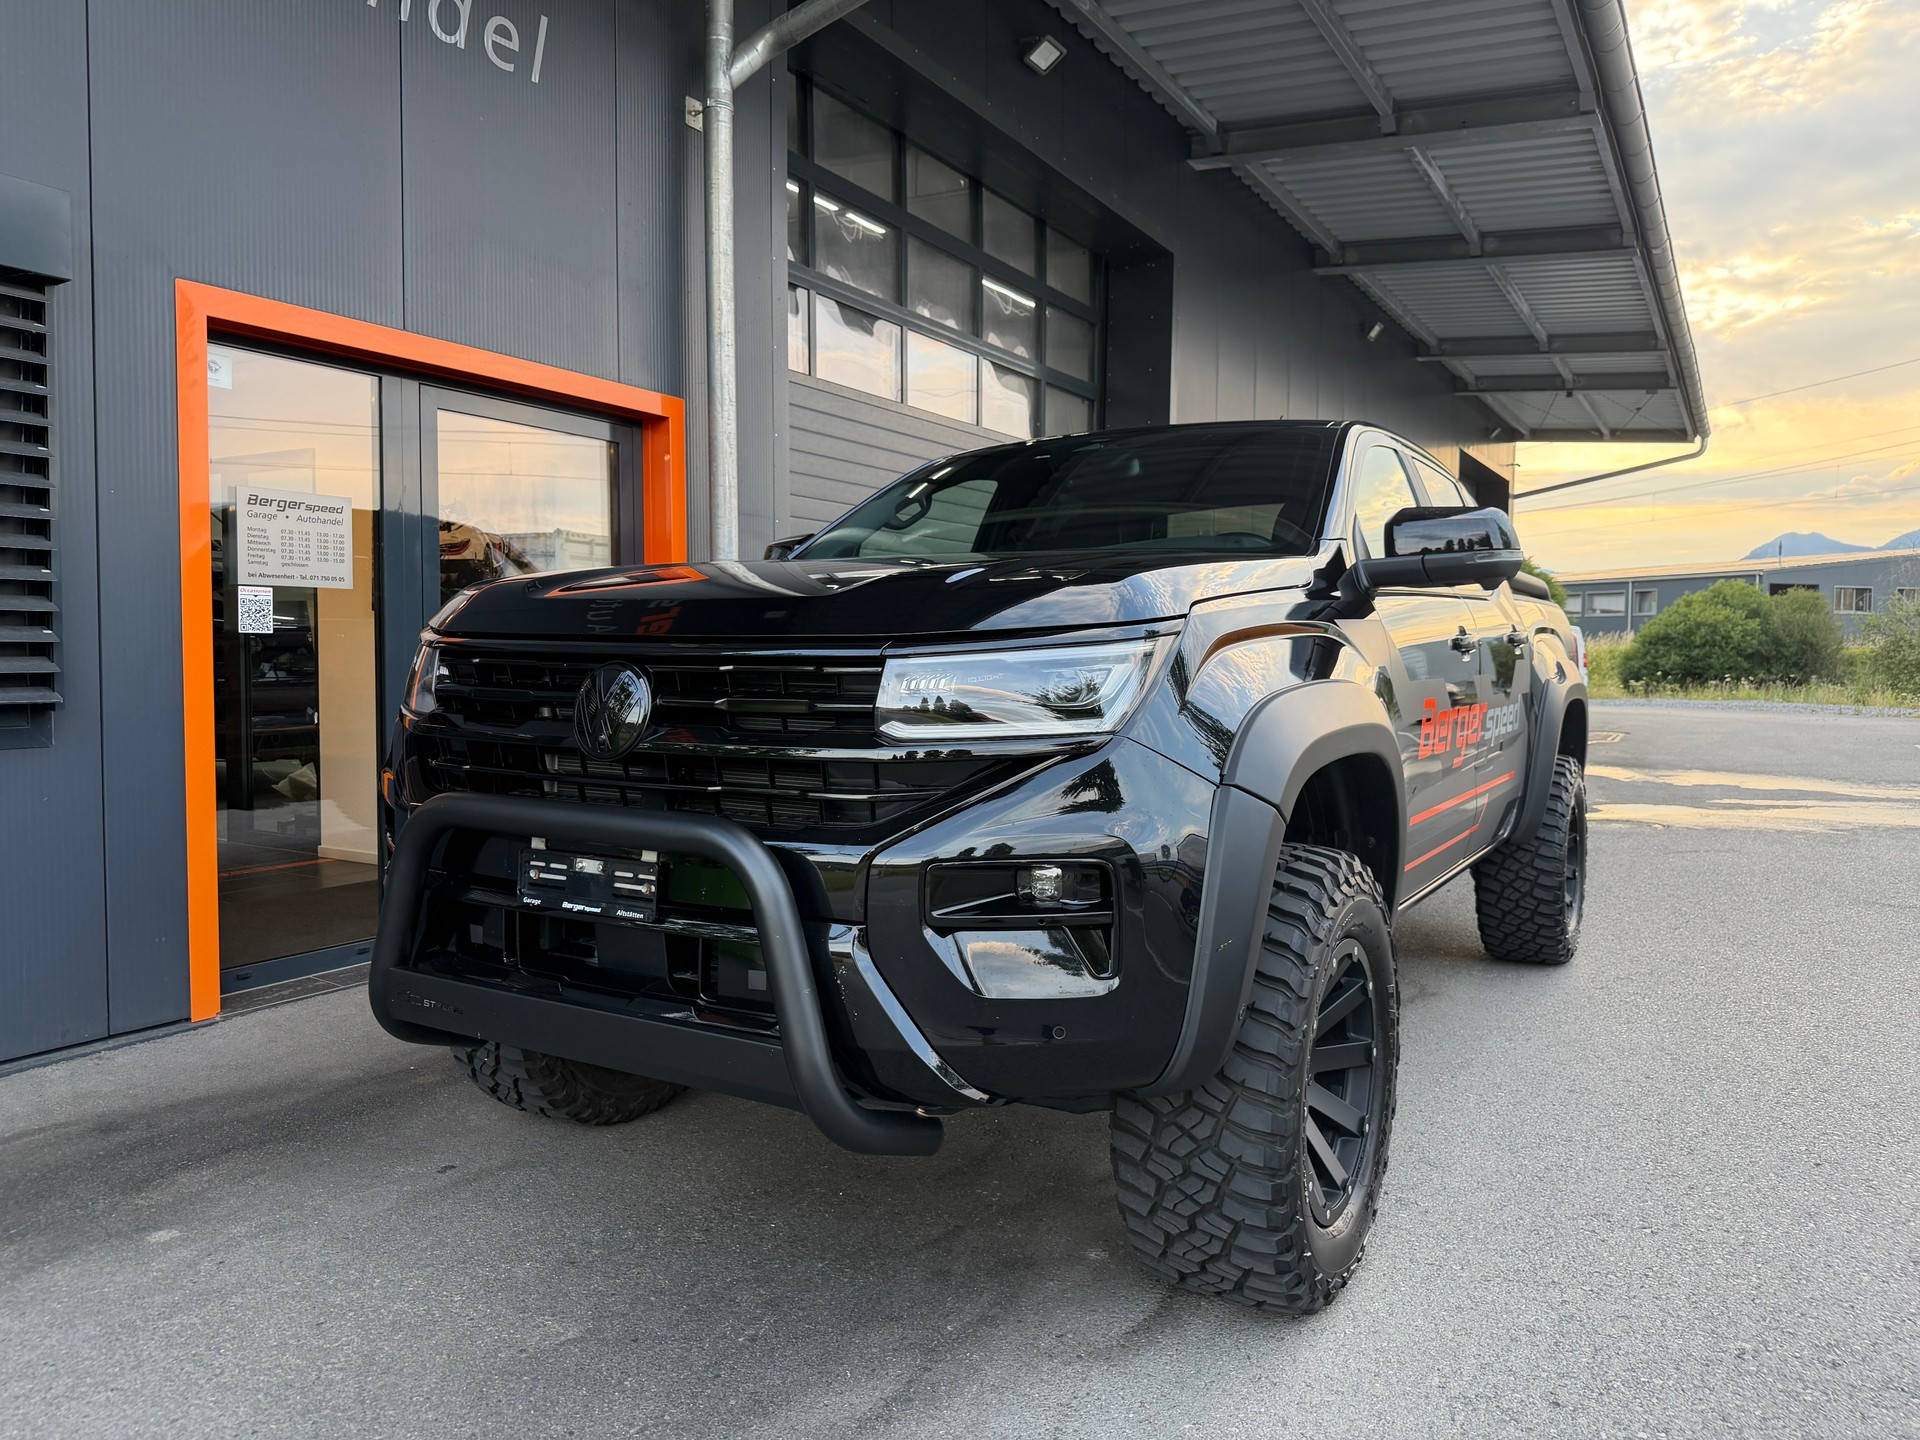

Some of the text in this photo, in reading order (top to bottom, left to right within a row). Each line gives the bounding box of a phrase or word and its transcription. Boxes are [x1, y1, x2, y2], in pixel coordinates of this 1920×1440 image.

[247, 494, 344, 514] Bergerspeed
[247, 510, 344, 526] Garage Autohandel
[247, 546, 276, 554] Donnerstag
[258, 572, 295, 580] Abwesenheit
[1418, 692, 1521, 769] Bergerspeed
[523, 896, 542, 905] Garage
[562, 901, 602, 912] Bergerspeed
[616, 909, 644, 919] Altstätten
